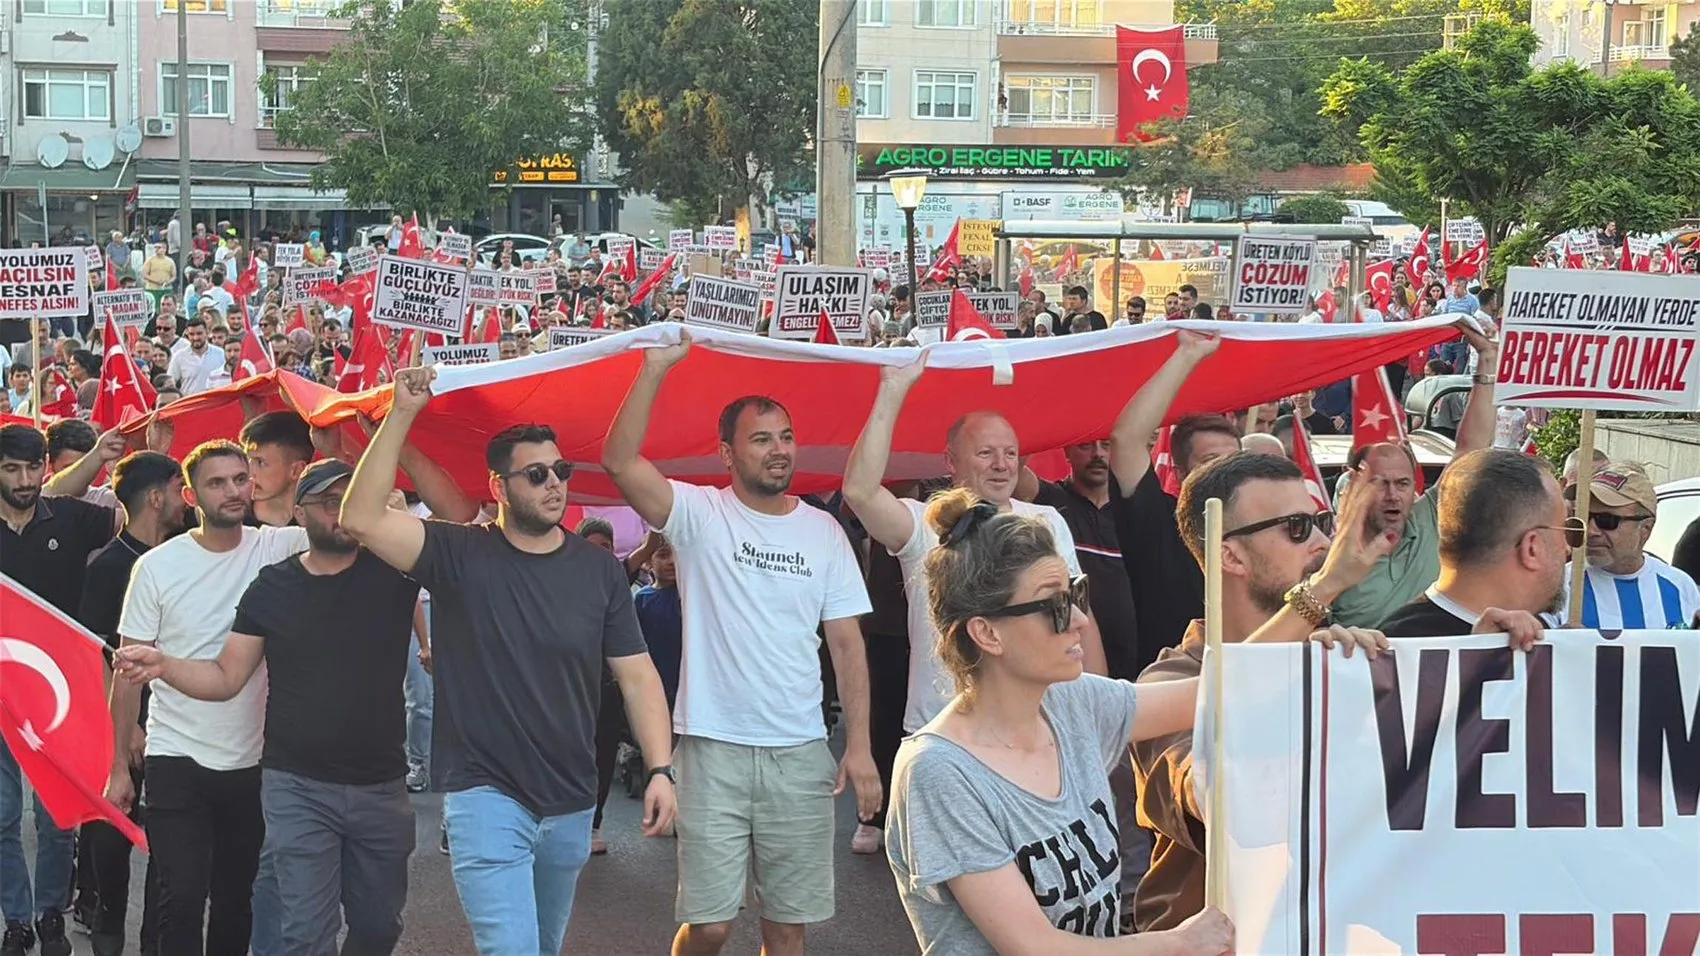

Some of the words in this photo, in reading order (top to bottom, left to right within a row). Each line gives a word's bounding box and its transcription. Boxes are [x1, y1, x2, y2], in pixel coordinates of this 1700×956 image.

[876, 148, 948, 166] AGRO
[952, 148, 1052, 167] ERGENE
[1026, 198, 1051, 206] BASF
[1244, 241, 1281, 260] ÜRETEN
[1283, 243, 1311, 260] KÖYLÜ
[0, 254, 74, 267] YOLUMUZ
[0, 267, 75, 284] AÇILSIN
[390, 263, 456, 284] BİRLİKTE
[501, 277, 512, 288] EK
[1242, 260, 1308, 287] ÇÖZÜM
[2, 284, 74, 297] ESNAF
[384, 276, 460, 298] GÜÇLÜYÜZ
[695, 280, 758, 307] YAŞLILARIMIZI
[789, 276, 859, 297] ULAŞIM
[1239, 286, 1304, 304] İSTİYOR!
[0, 298, 37, 310] NEFES
[41, 297, 79, 310] ALSIN!
[393, 300, 444, 317] BİRLİKTE
[970, 299, 988, 310] TEK
[992, 299, 1013, 310] YOL.
[1507, 292, 1577, 320] HAREKET
[1578, 294, 1650, 323] OLMAYAN
[1651, 298, 1699, 326] YERDE
[380, 307, 456, 328] KAZANACAĞIZ!
[691, 300, 754, 327] UNUTMAYIN!
[784, 316, 859, 329] ENGELLEMEZ!
[553, 333, 587, 345] ÜRETEN
[432, 348, 488, 360] YOLUMUZ
[1497, 331, 1609, 388] BEREKET
[1608, 335, 1695, 391] OLMAZ
[742, 542, 804, 565] Staunch
[790, 565, 812, 577] Club
[1369, 630, 1700, 830] VELİM
